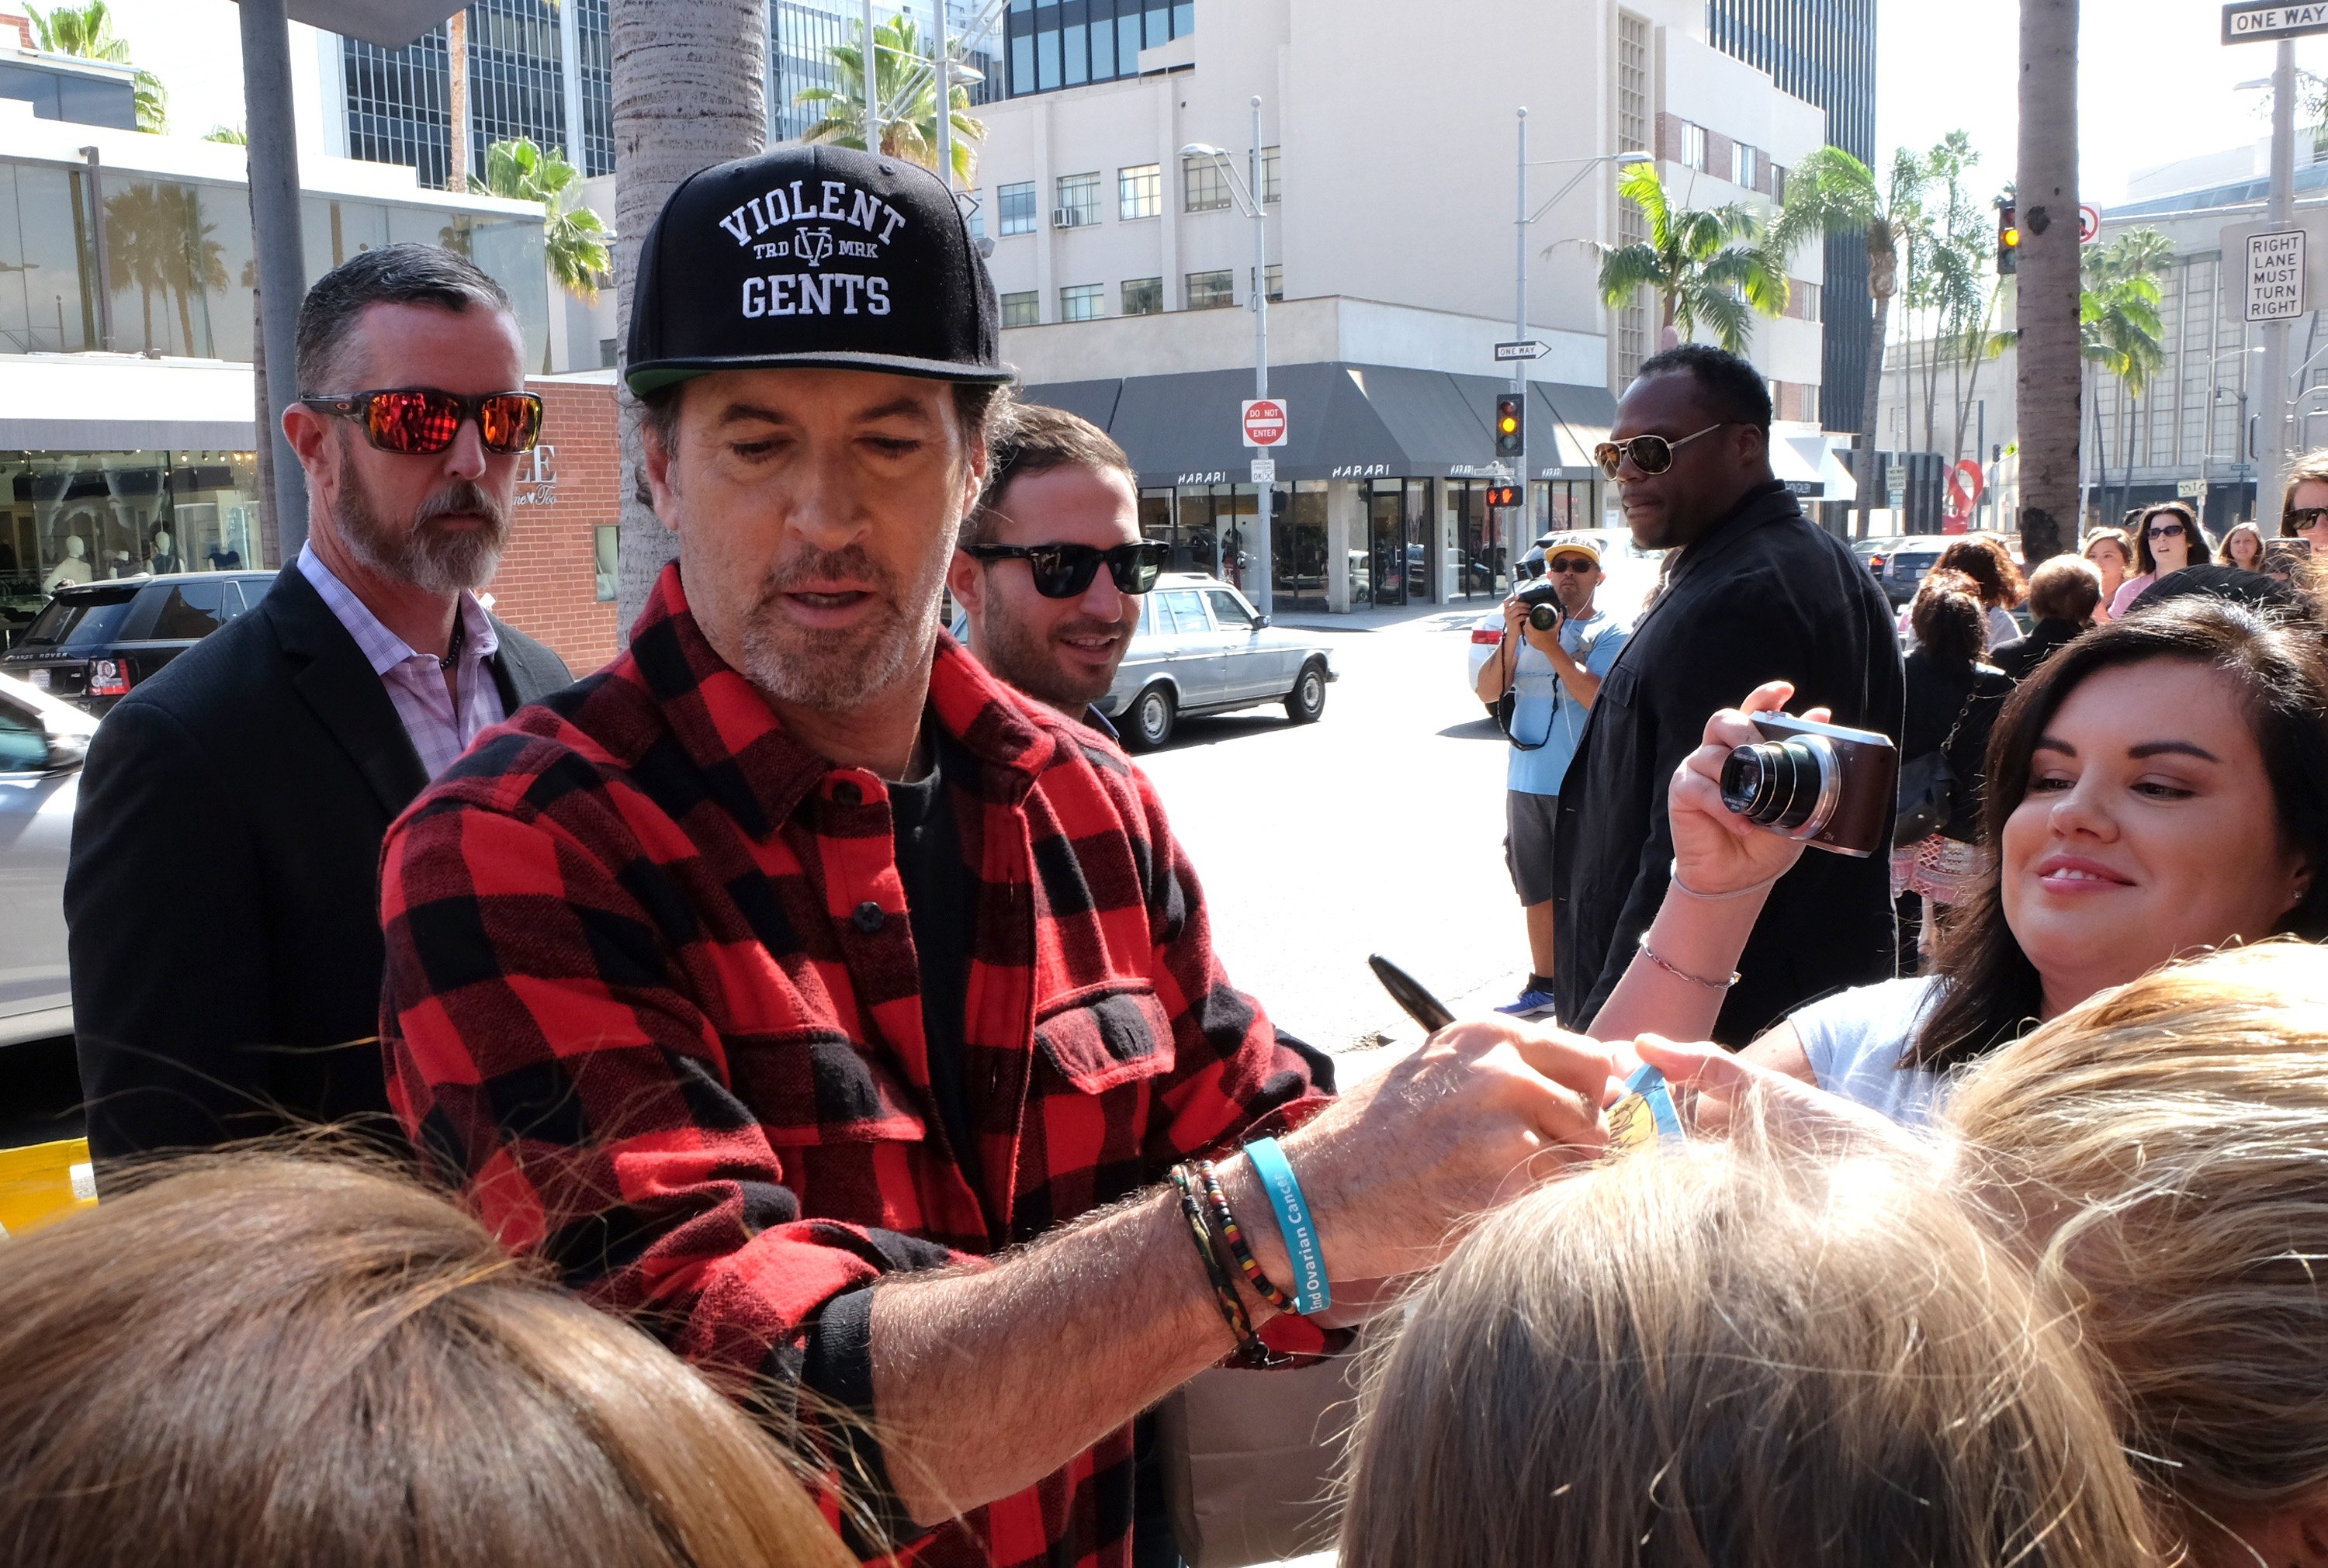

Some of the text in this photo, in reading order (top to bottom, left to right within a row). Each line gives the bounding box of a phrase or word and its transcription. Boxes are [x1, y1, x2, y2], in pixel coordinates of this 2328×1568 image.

[2236, 5, 2326, 31] ONE WAY
[719, 180, 906, 247] VIOLENT
[753, 241, 789, 260] TRD
[838, 240, 878, 258] MRK
[2253, 237, 2299, 253] RIGHT
[2254, 253, 2297, 268] LANE
[2254, 268, 2297, 285] MUST
[743, 273, 892, 319] GENTS
[2254, 284, 2296, 299] TURN
[2251, 299, 2297, 316] RIGHT
[1500, 348, 1516, 356] ONE
[1249, 409, 1279, 417] DO NOT
[1253, 429, 1277, 438] ENTER
[1178, 471, 1226, 485] HARARI
[1332, 464, 1391, 478] HARARI
[1450, 464, 1474, 476] HARARI
[535, 484, 557, 506] Too
[1274, 1175, 1302, 1224] Cancer
[1299, 1227, 1320, 1290] Ovarian
